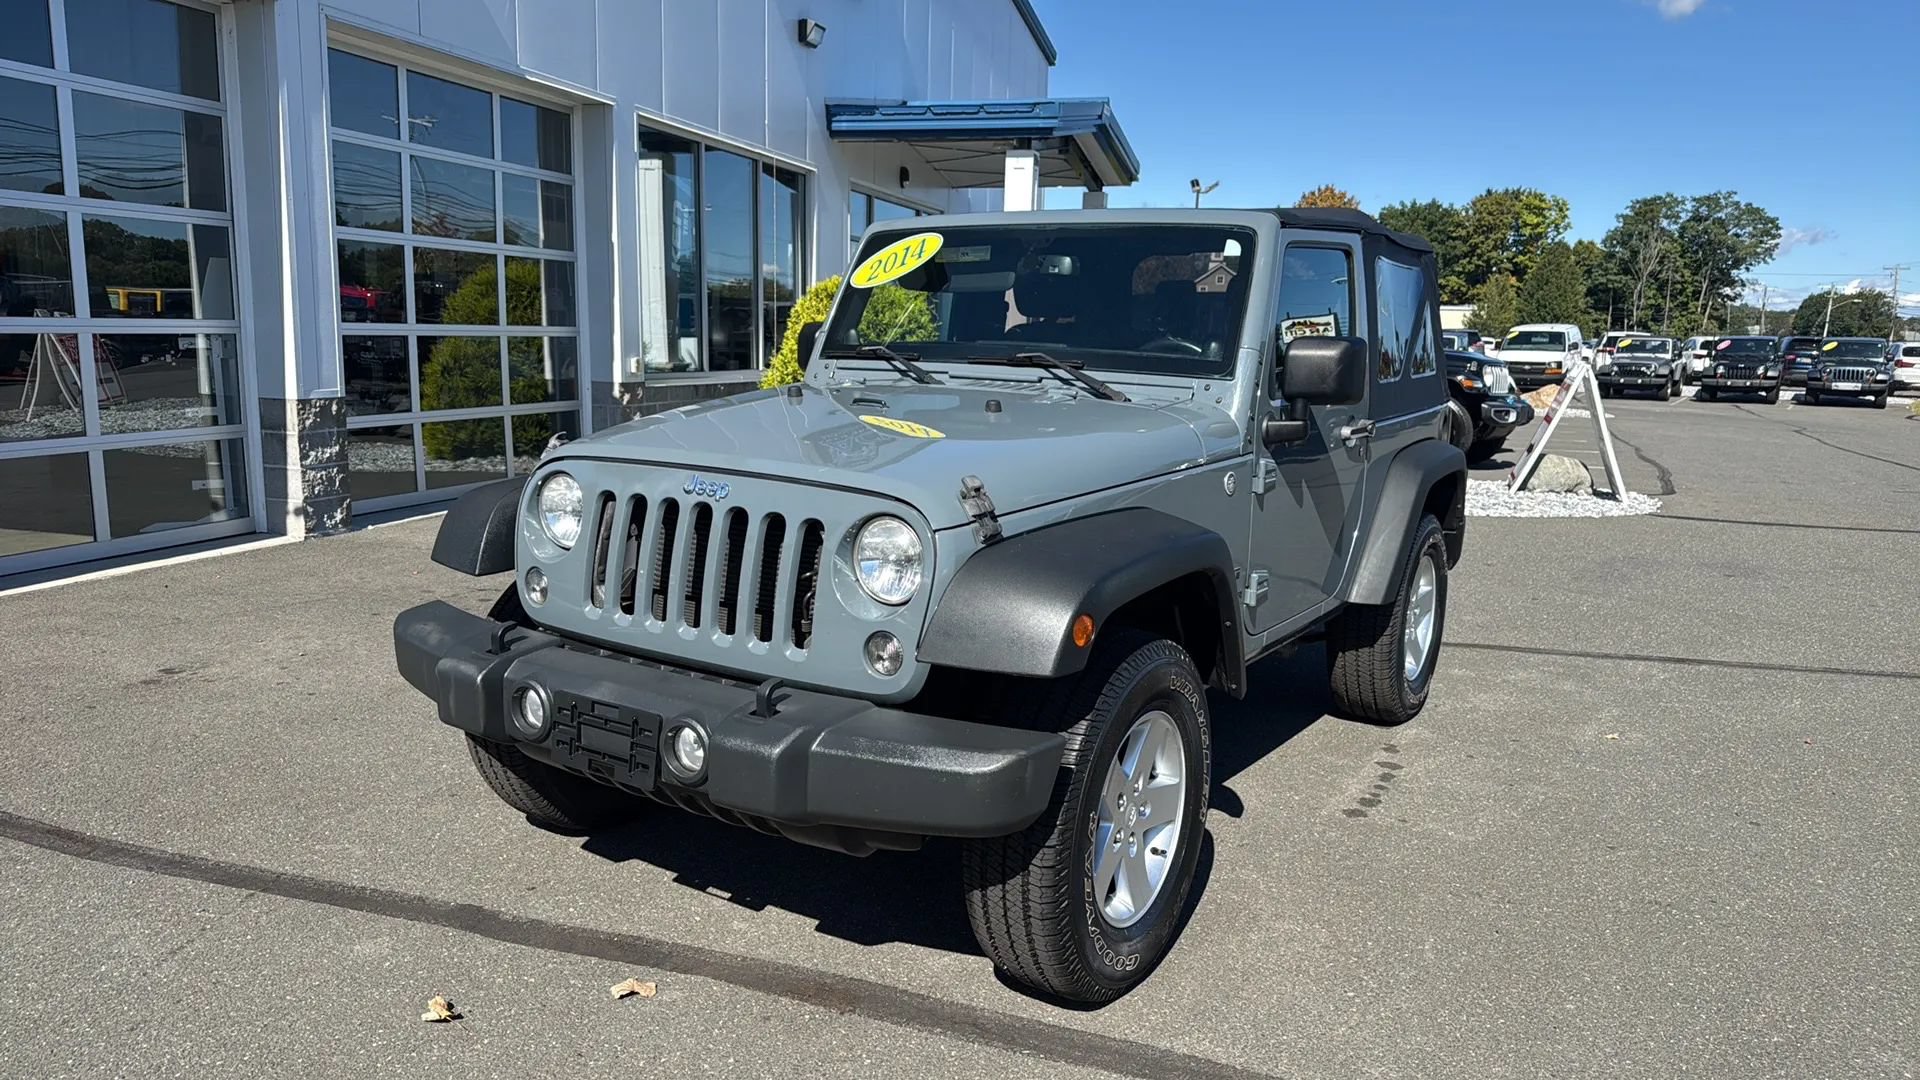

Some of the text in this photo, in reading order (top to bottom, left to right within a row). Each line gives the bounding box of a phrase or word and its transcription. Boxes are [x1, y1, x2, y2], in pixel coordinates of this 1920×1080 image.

[866, 238, 926, 282] 2014
[682, 474, 730, 502] Jeep
[1169, 674, 1211, 823] WRANGLER
[1084, 810, 1140, 971] GOODYEAR
